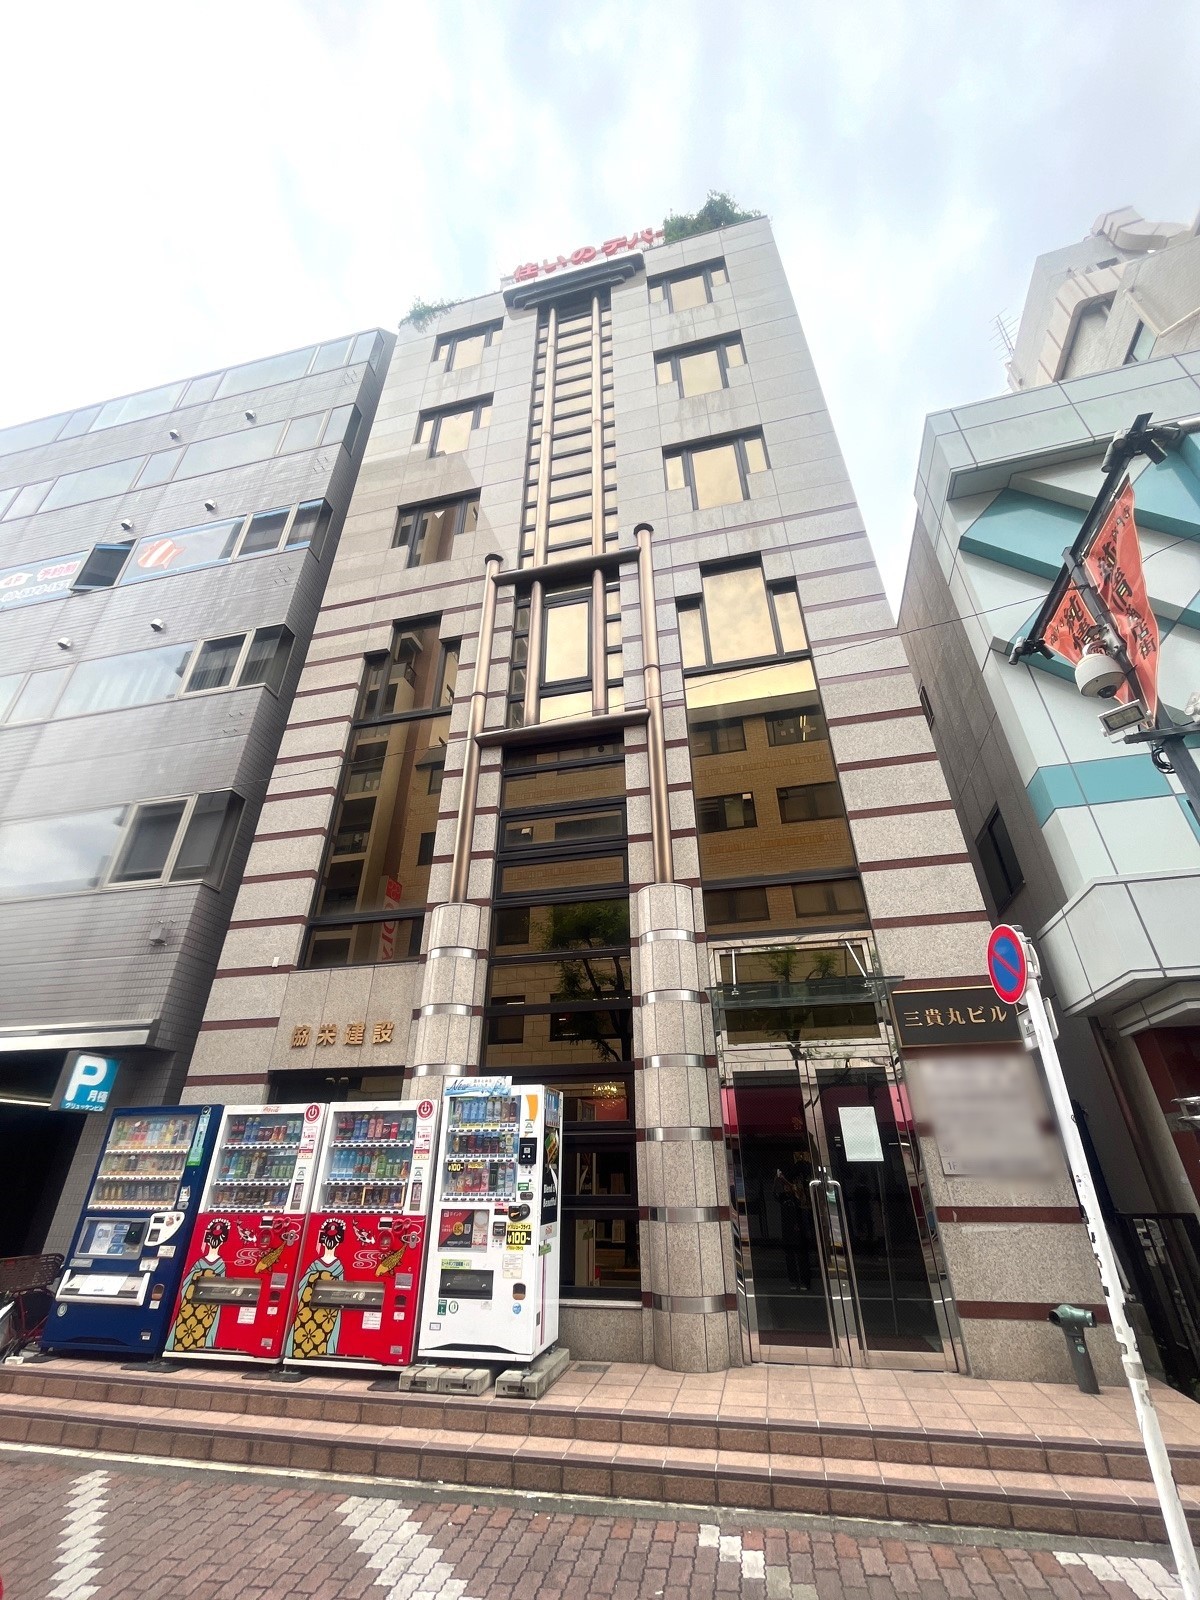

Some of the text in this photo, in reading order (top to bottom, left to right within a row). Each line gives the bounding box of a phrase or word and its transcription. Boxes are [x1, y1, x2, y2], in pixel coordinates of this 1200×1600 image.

[903, 1005, 1007, 1027] 三貴丸ビル
[291, 1021, 395, 1048] 協栄建設
[65, 1055, 107, 1101] P
[87, 1090, 108, 1102] 月極
